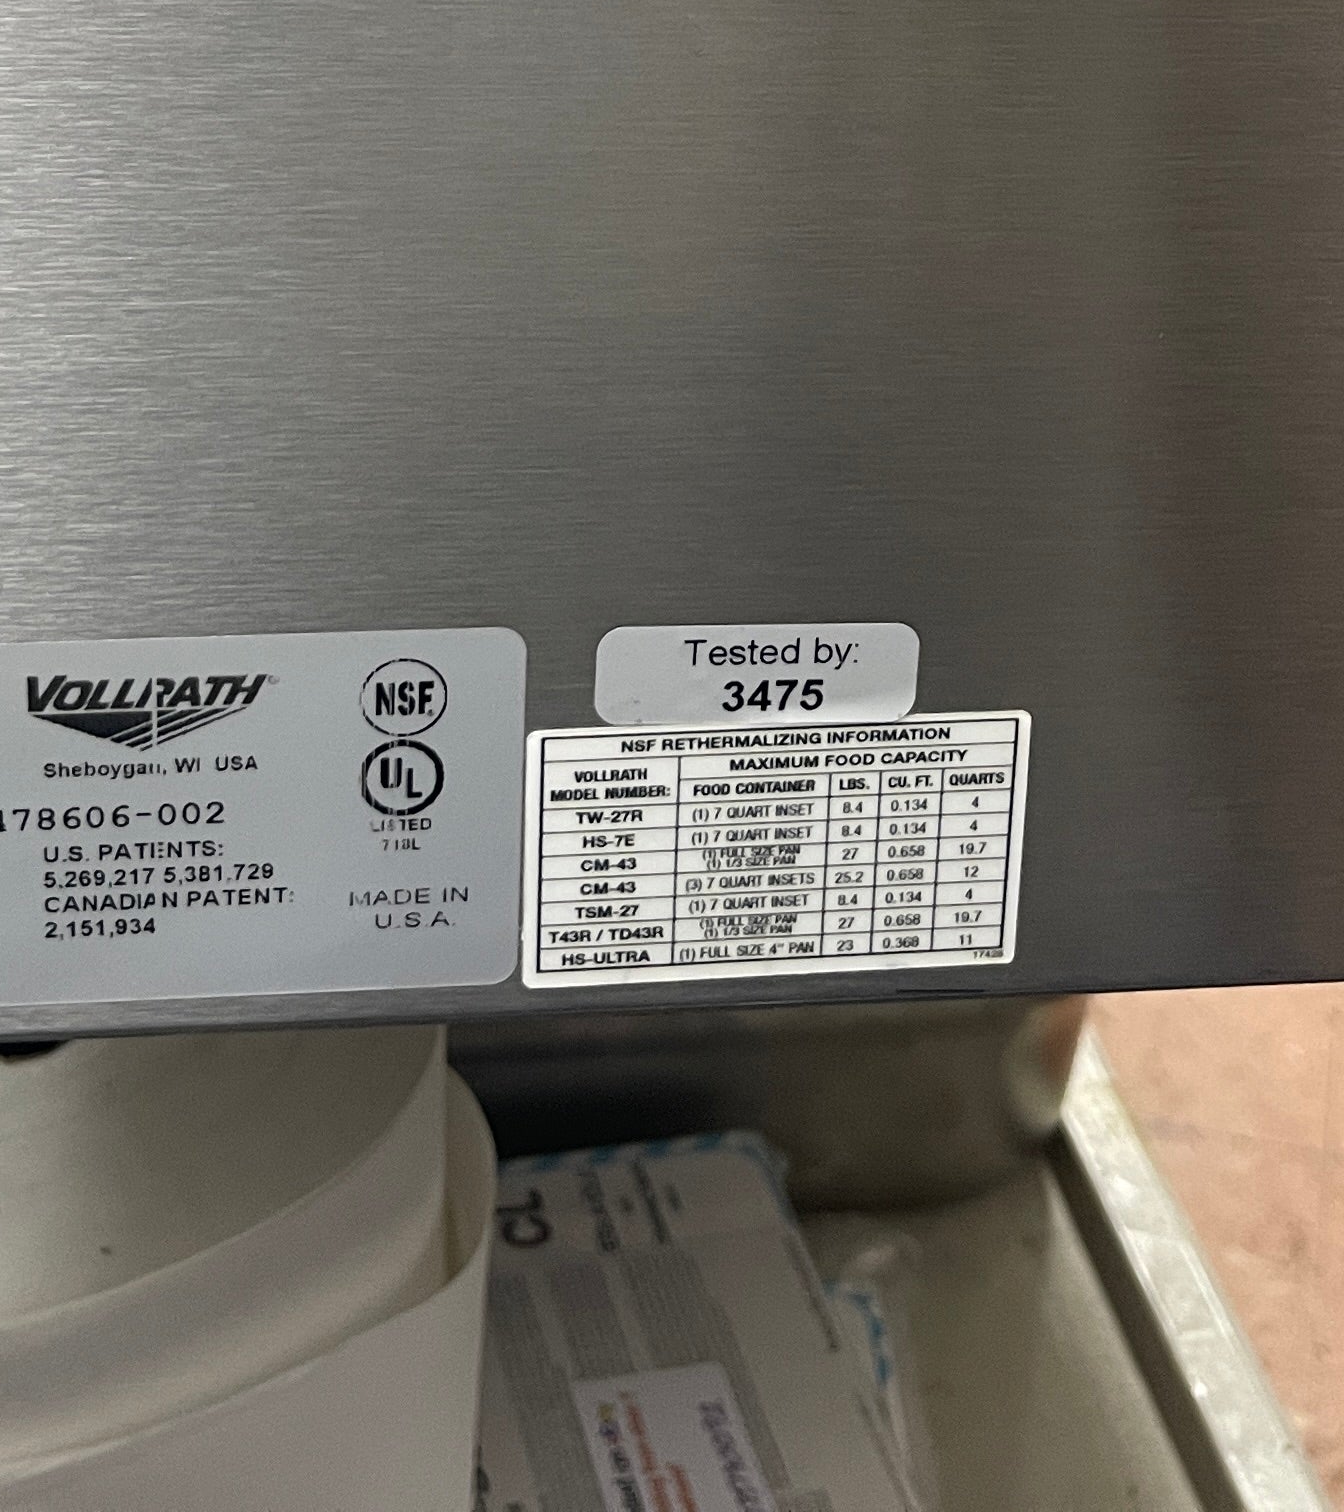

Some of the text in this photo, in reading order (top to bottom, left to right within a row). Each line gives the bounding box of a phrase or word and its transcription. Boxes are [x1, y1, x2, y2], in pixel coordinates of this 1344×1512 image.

[684, 638, 859, 670] Tested by:
[27, 674, 266, 712] VOLLRATH
[375, 681, 434, 716] NSF
[721, 679, 825, 712] 3475
[621, 728, 951, 752] NSF RETHERMALIZING INFORMATION
[729, 750, 968, 771] MAXIMUM FOOD CAPACITY
[44, 756, 258, 780] Sheboygan, WI USA
[380, 757, 422, 798] UL
[574, 768, 647, 783] VOLLRATH
[888, 775, 933, 788] CU. FT.
[949, 772, 1004, 786] QUARTS
[693, 778, 816, 796] FOOD CONTAINER
[839, 778, 870, 790] LBS.
[550, 786, 670, 801] MODEL NUMBER:
[843, 801, 862, 813] 8.4
[890, 798, 928, 812] 0.134
[972, 796, 979, 808] 4
[576, 810, 643, 824] TW-27R
[692, 803, 814, 822] (1) 7 QUART INSET
[841, 825, 861, 836] 8.4
[889, 822, 926, 835] 0.134
[970, 820, 978, 832] 4
[582, 834, 635, 848] HS-7E
[692, 826, 813, 846] (1) 7 QUART INSET
[44, 840, 224, 864] U.S. PATENTS:
[720, 846, 748, 858] FULL
[751, 845, 776, 857] SIZE
[778, 844, 800, 855] PAN
[842, 848, 859, 860] 27
[888, 845, 925, 858] 0.658
[959, 842, 987, 854] 19.7
[580, 858, 637, 872] CM-43
[726, 858, 742, 868] 1/3
[745, 856, 770, 867] SIZE
[773, 855, 796, 865] PAN
[835, 871, 864, 883] 25.2
[887, 868, 924, 881] 0.658
[964, 866, 979, 877] 12
[580, 881, 636, 895] CM-43
[685, 873, 814, 892] (3) 7 QUART INSETS
[45, 887, 294, 914] CANADIAN PATENT:
[349, 887, 469, 907] MADE IN
[838, 894, 858, 905] 8.4
[885, 891, 922, 904] 0.134
[965, 888, 973, 900] 4
[688, 894, 809, 913] (1) 7 QUART INSET
[575, 905, 639, 919] TSM-27
[955, 910, 982, 923] 19.7
[717, 917, 746, 927] FULL
[775, 914, 797, 924] PAN
[838, 917, 855, 929] 27
[884, 914, 921, 926] 0.658
[45, 917, 156, 940] 2,151,934
[549, 927, 664, 944] T43R / TD43R
[723, 926, 740, 937] 1/3
[742, 925, 767, 935] SIZE
[770, 924, 793, 934] PAN
[837, 940, 854, 951] 23
[882, 936, 919, 949] 0.368
[959, 934, 973, 945] 11
[562, 951, 650, 966] HS-ULTRA
[679, 948, 695, 962] (1)
[700, 946, 730, 959] FULL
[737, 944, 763, 957] SIZE
[788, 942, 814, 954] PAN
